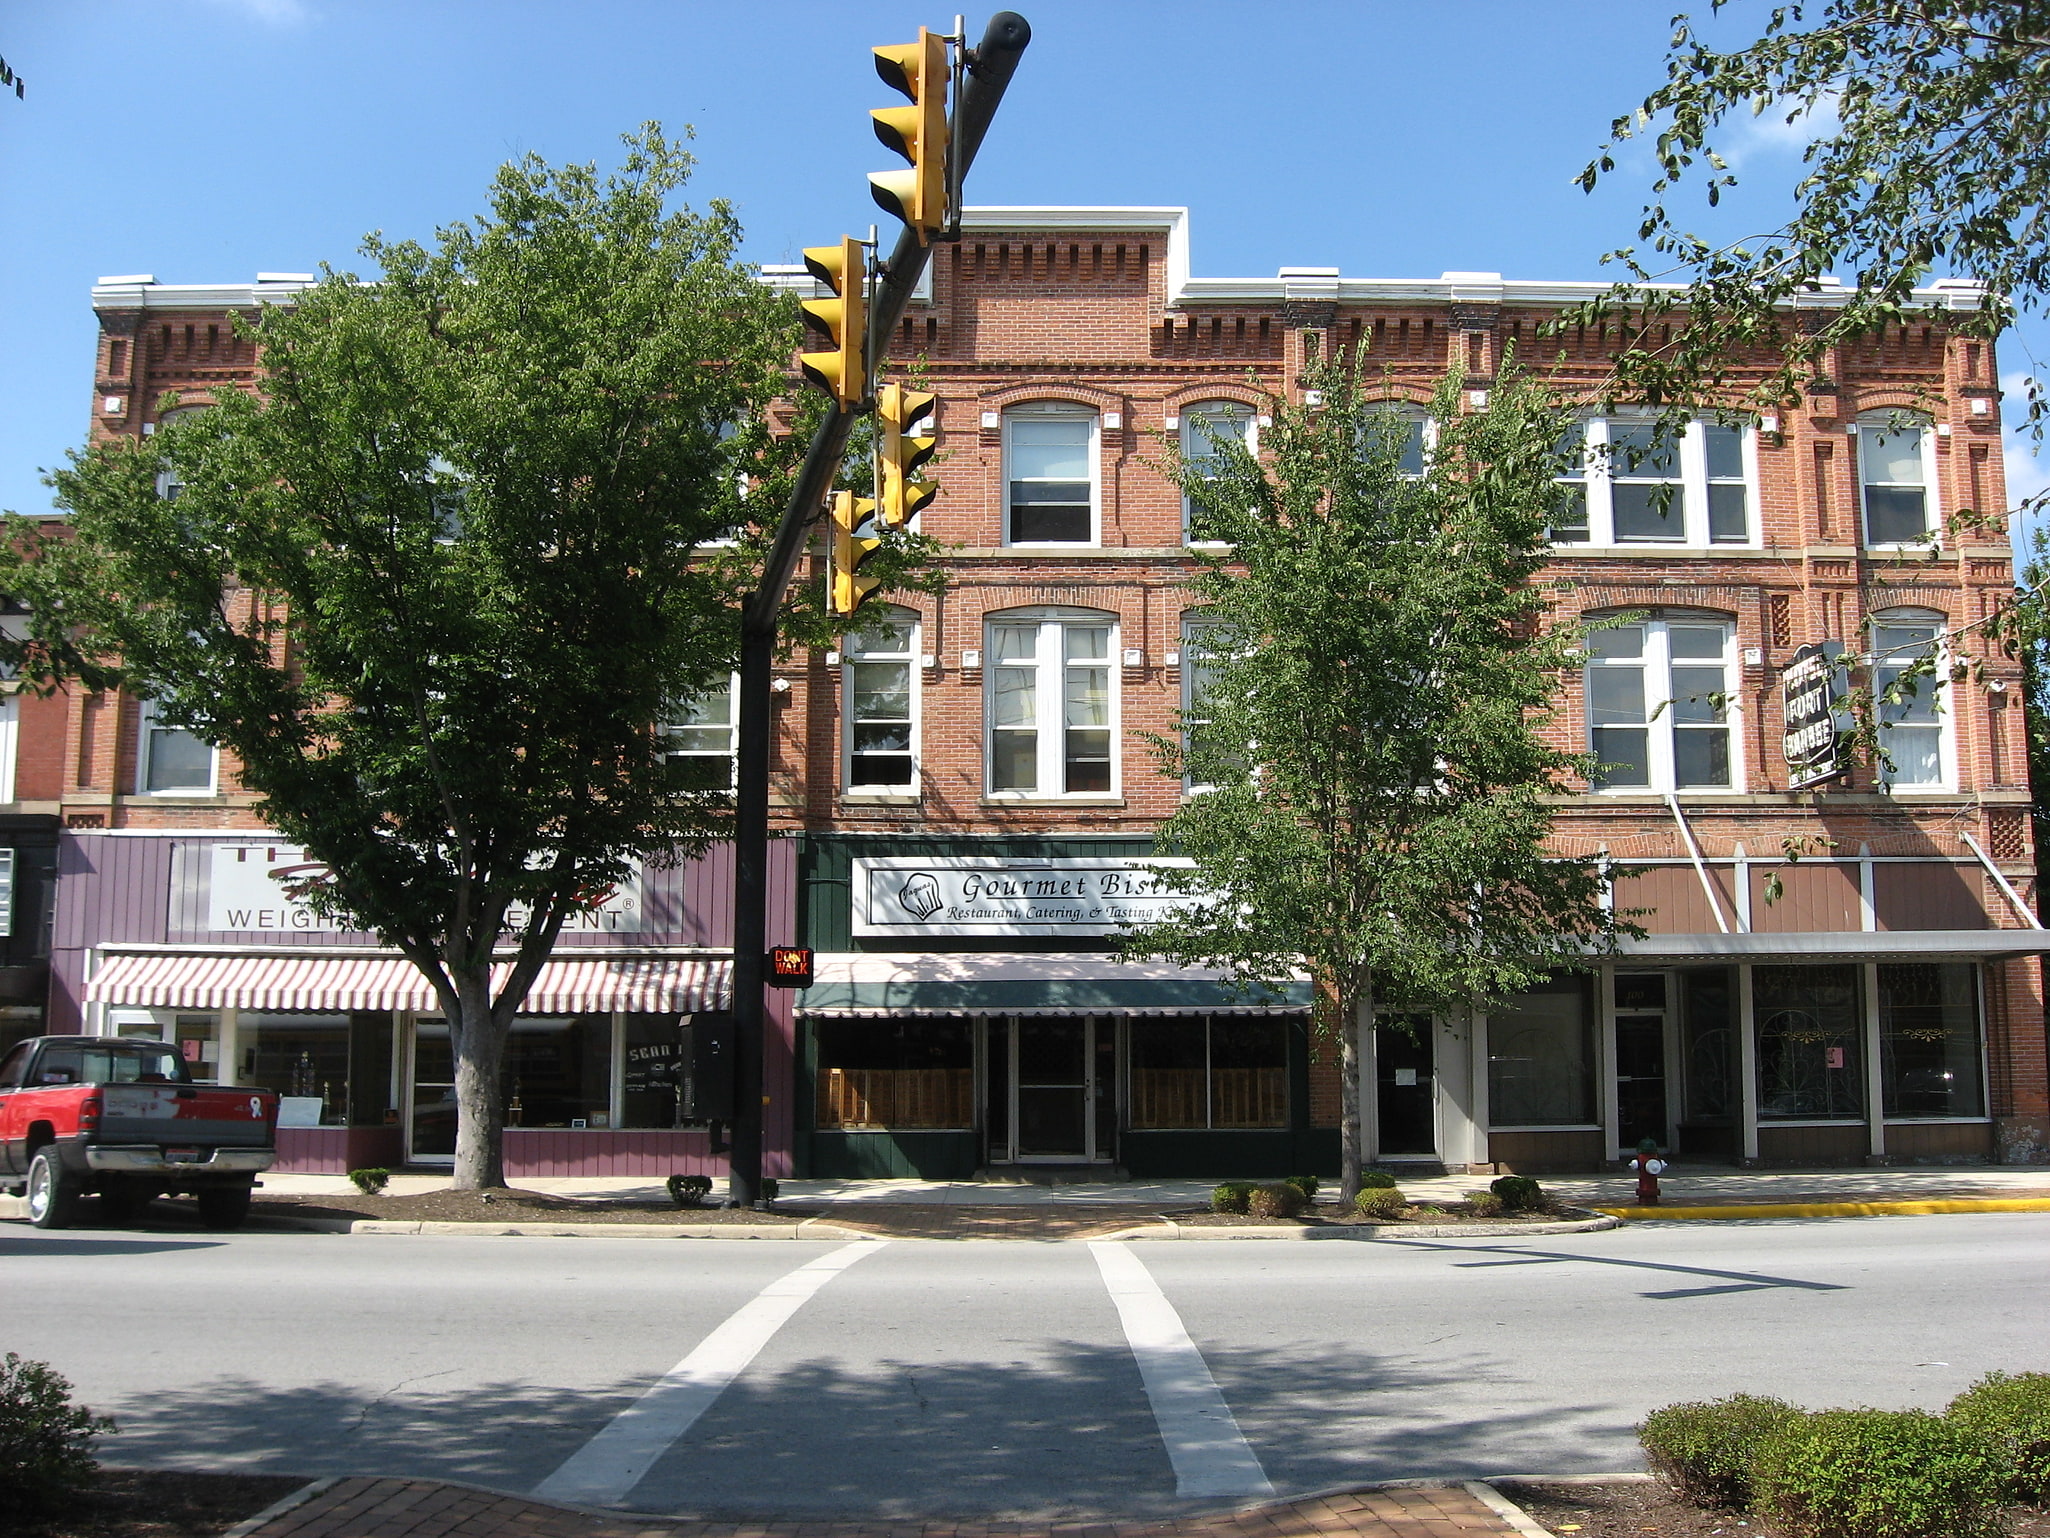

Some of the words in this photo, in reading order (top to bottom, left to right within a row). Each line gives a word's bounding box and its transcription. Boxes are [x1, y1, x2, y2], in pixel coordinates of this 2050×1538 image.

[1787, 688, 1823, 723] FORT
[963, 873, 1086, 903] Gourmet
[947, 905, 1022, 920] Restaurant,
[1026, 905, 1083, 921] Catering,
[1088, 905, 1101, 918] &
[1106, 905, 1153, 920] Tasting
[775, 962, 808, 975] WALK
